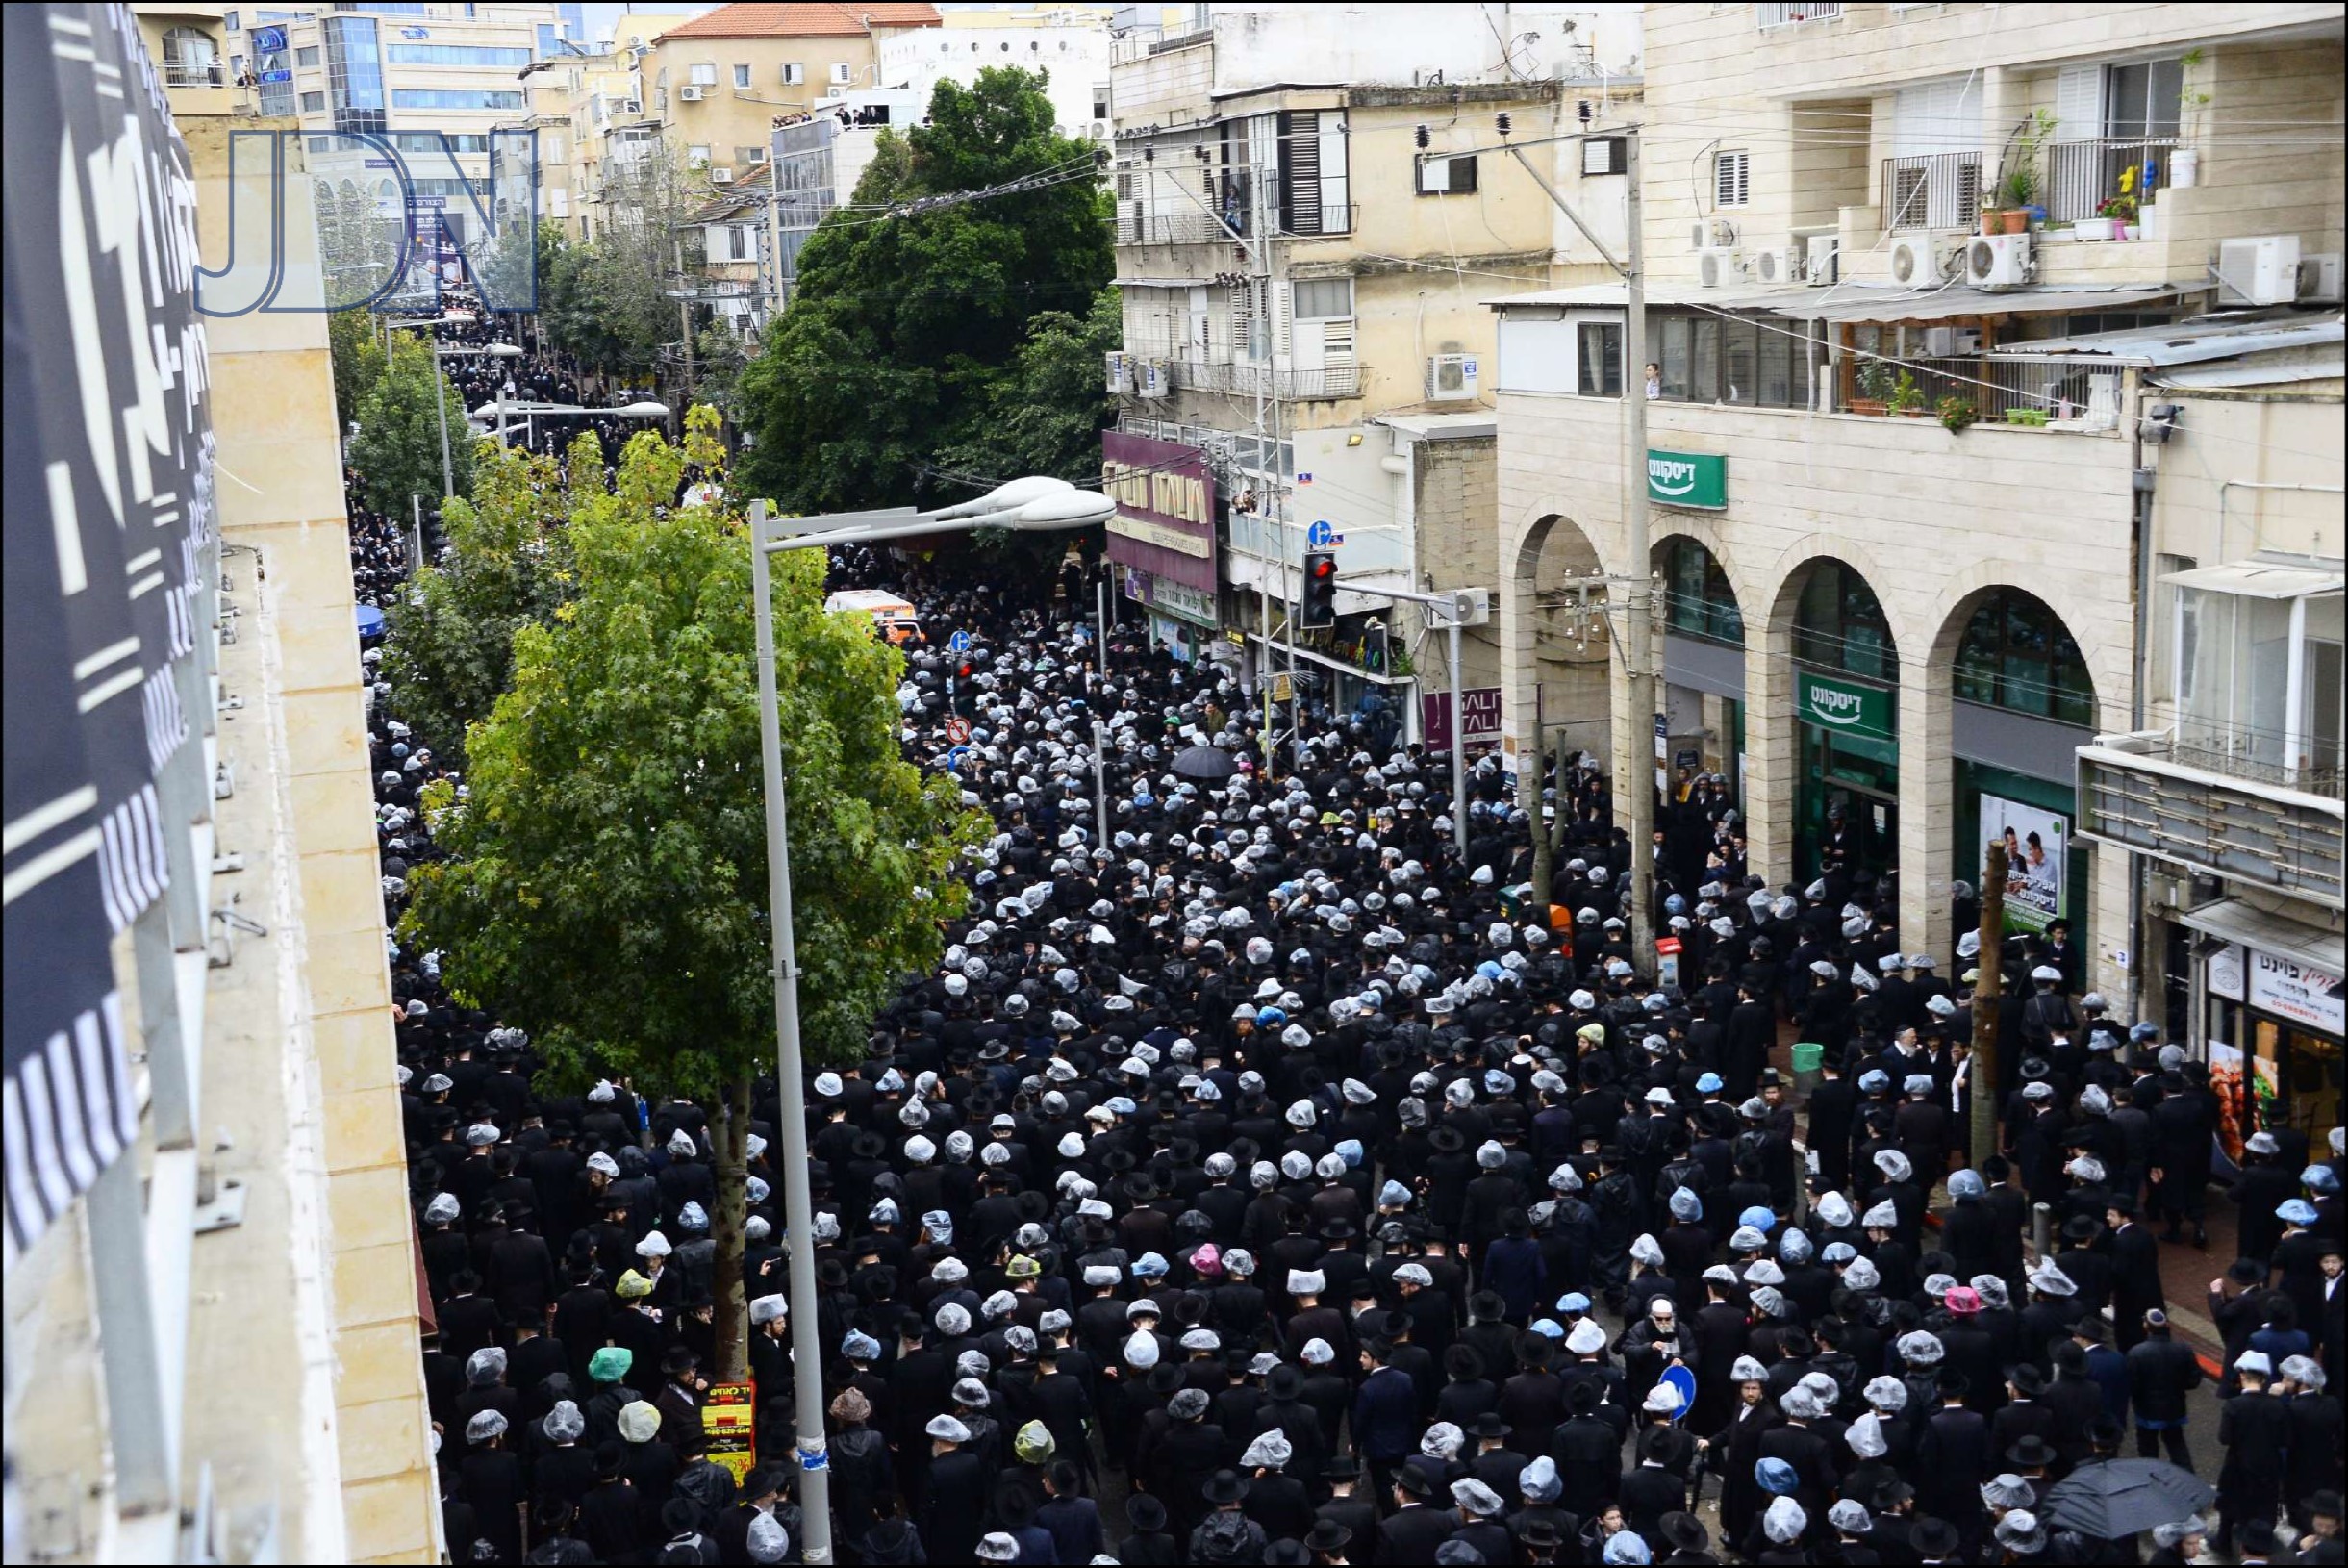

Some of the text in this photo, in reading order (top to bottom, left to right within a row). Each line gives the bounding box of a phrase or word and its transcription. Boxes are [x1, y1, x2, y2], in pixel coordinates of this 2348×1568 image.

[1648, 458, 1696, 484] דיסקונט
[1810, 684, 1863, 714] דיסקונט
[2019, 887, 2056, 908] דיסקונט
[2260, 954, 2300, 979] פוינט
